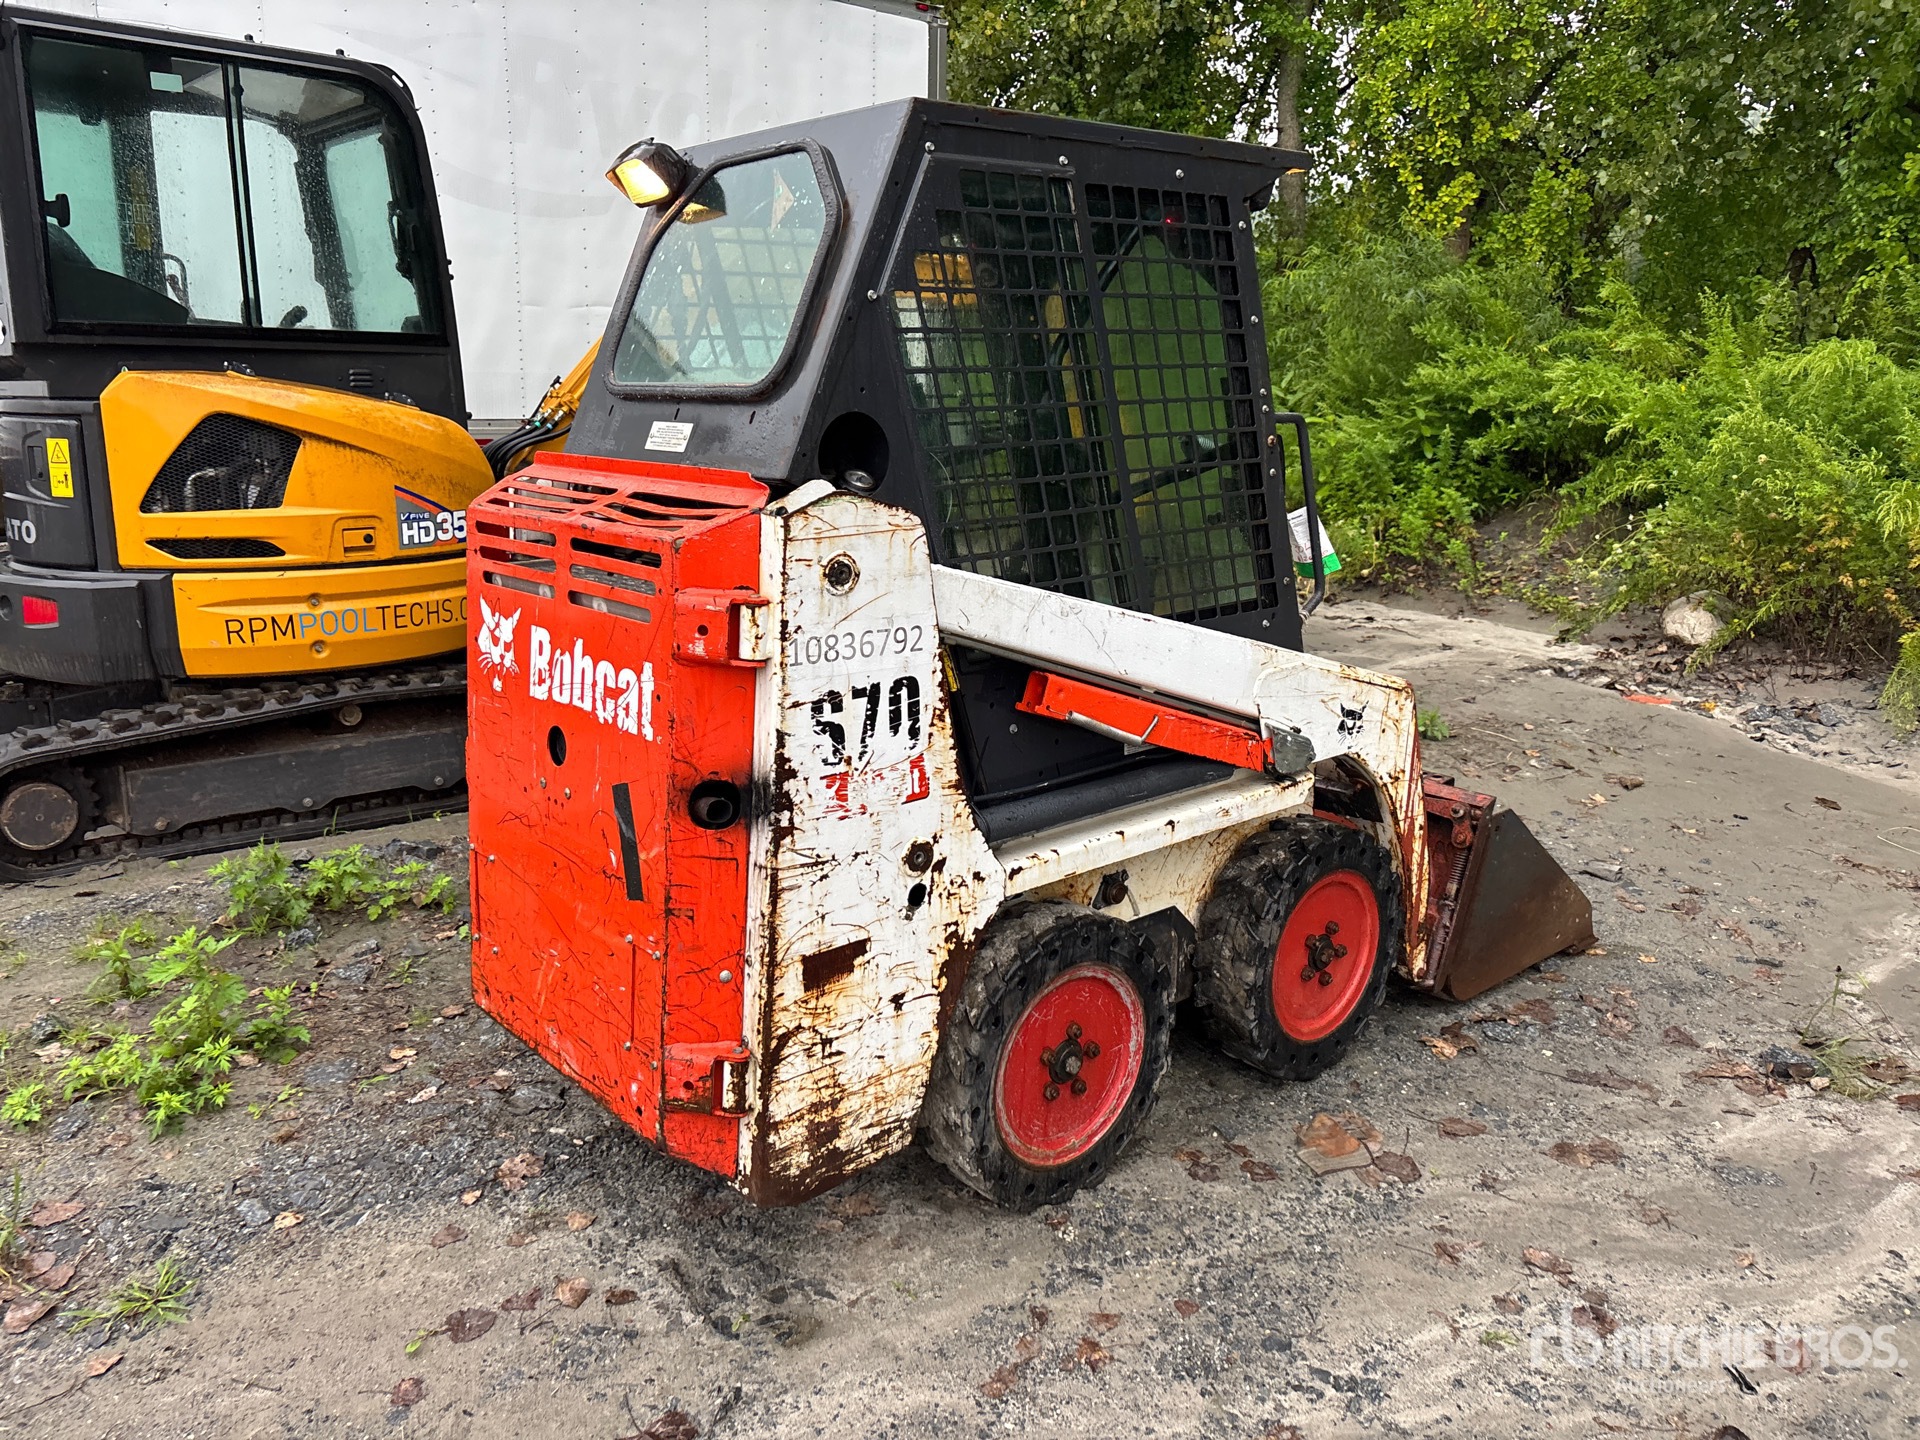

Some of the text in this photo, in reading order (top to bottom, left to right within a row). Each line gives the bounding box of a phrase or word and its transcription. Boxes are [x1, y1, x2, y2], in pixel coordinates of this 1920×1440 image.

[5, 516, 37, 544] ATO
[788, 624, 924, 668] 10836792
[529, 624, 655, 742] Bobcat
[810, 675, 921, 768] S70
